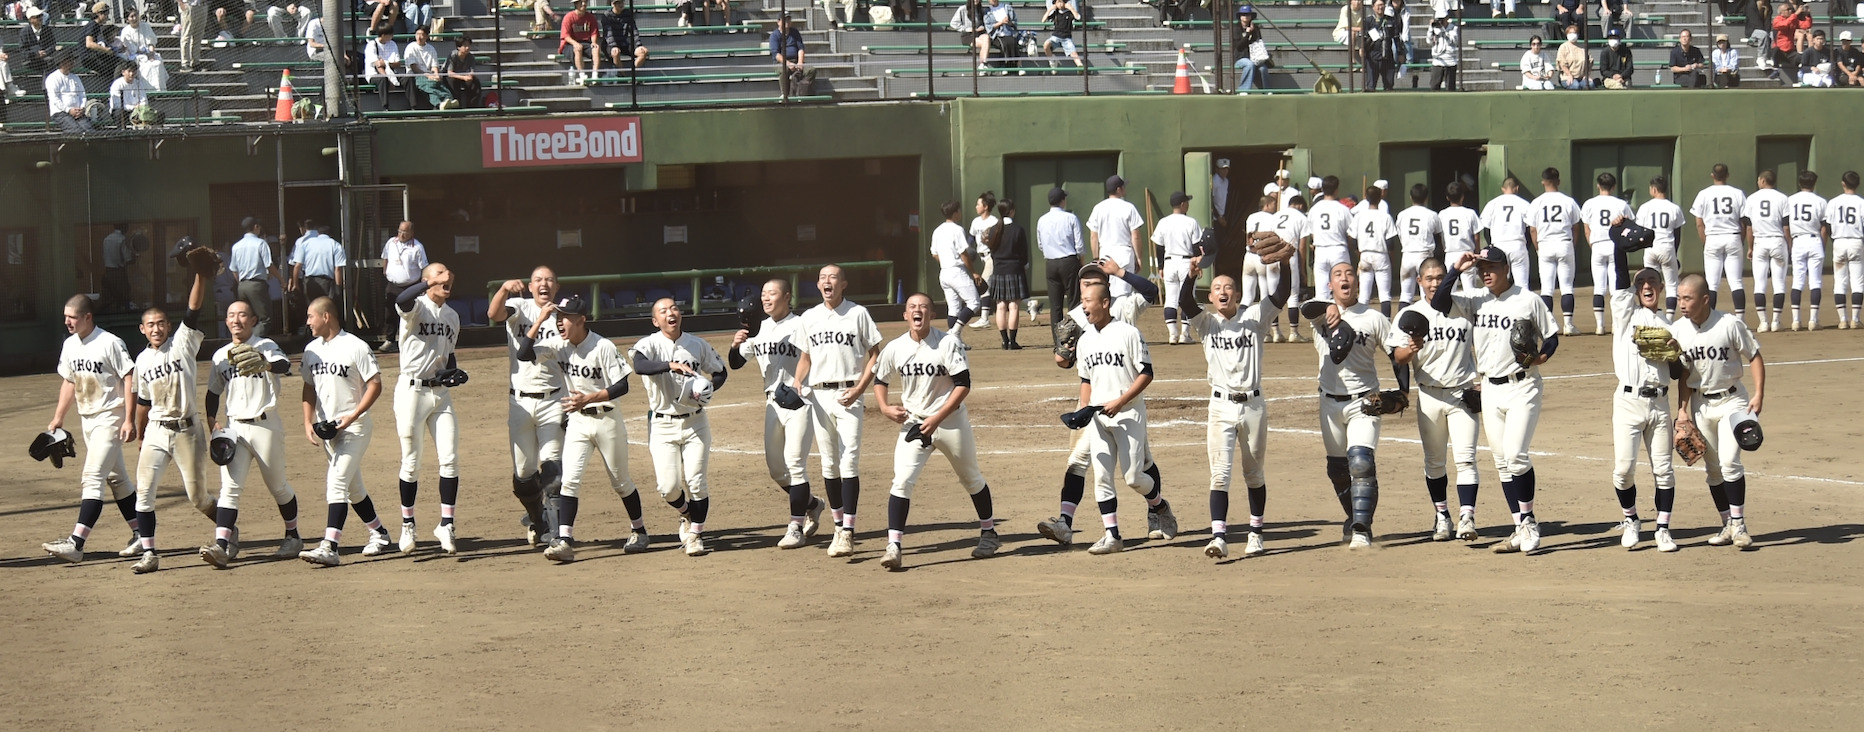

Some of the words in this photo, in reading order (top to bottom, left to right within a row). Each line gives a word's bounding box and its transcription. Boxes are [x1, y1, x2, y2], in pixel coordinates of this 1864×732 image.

[485, 122, 637, 162] ThreeBond
[1503, 205, 1514, 222] 7
[1543, 205, 1562, 222] 12
[1712, 197, 1733, 215] 13
[1760, 200, 1771, 217] 9
[1793, 204, 1813, 222] 15
[1838, 205, 1856, 224] 16
[1277, 215, 1289, 229] 2
[1320, 213, 1331, 230] 3
[1600, 209, 1611, 226] 8
[1651, 212, 1670, 229] 10
[1365, 221, 1375, 238] 4
[1408, 218, 1421, 235] 5
[1449, 219, 1459, 236] 6
[1473, 314, 1516, 331] NIHO
[810, 331, 857, 348] NIHON
[1211, 335, 1253, 351] NIHON
[1423, 326, 1467, 343] IHON
[754, 342, 798, 358] NIHON
